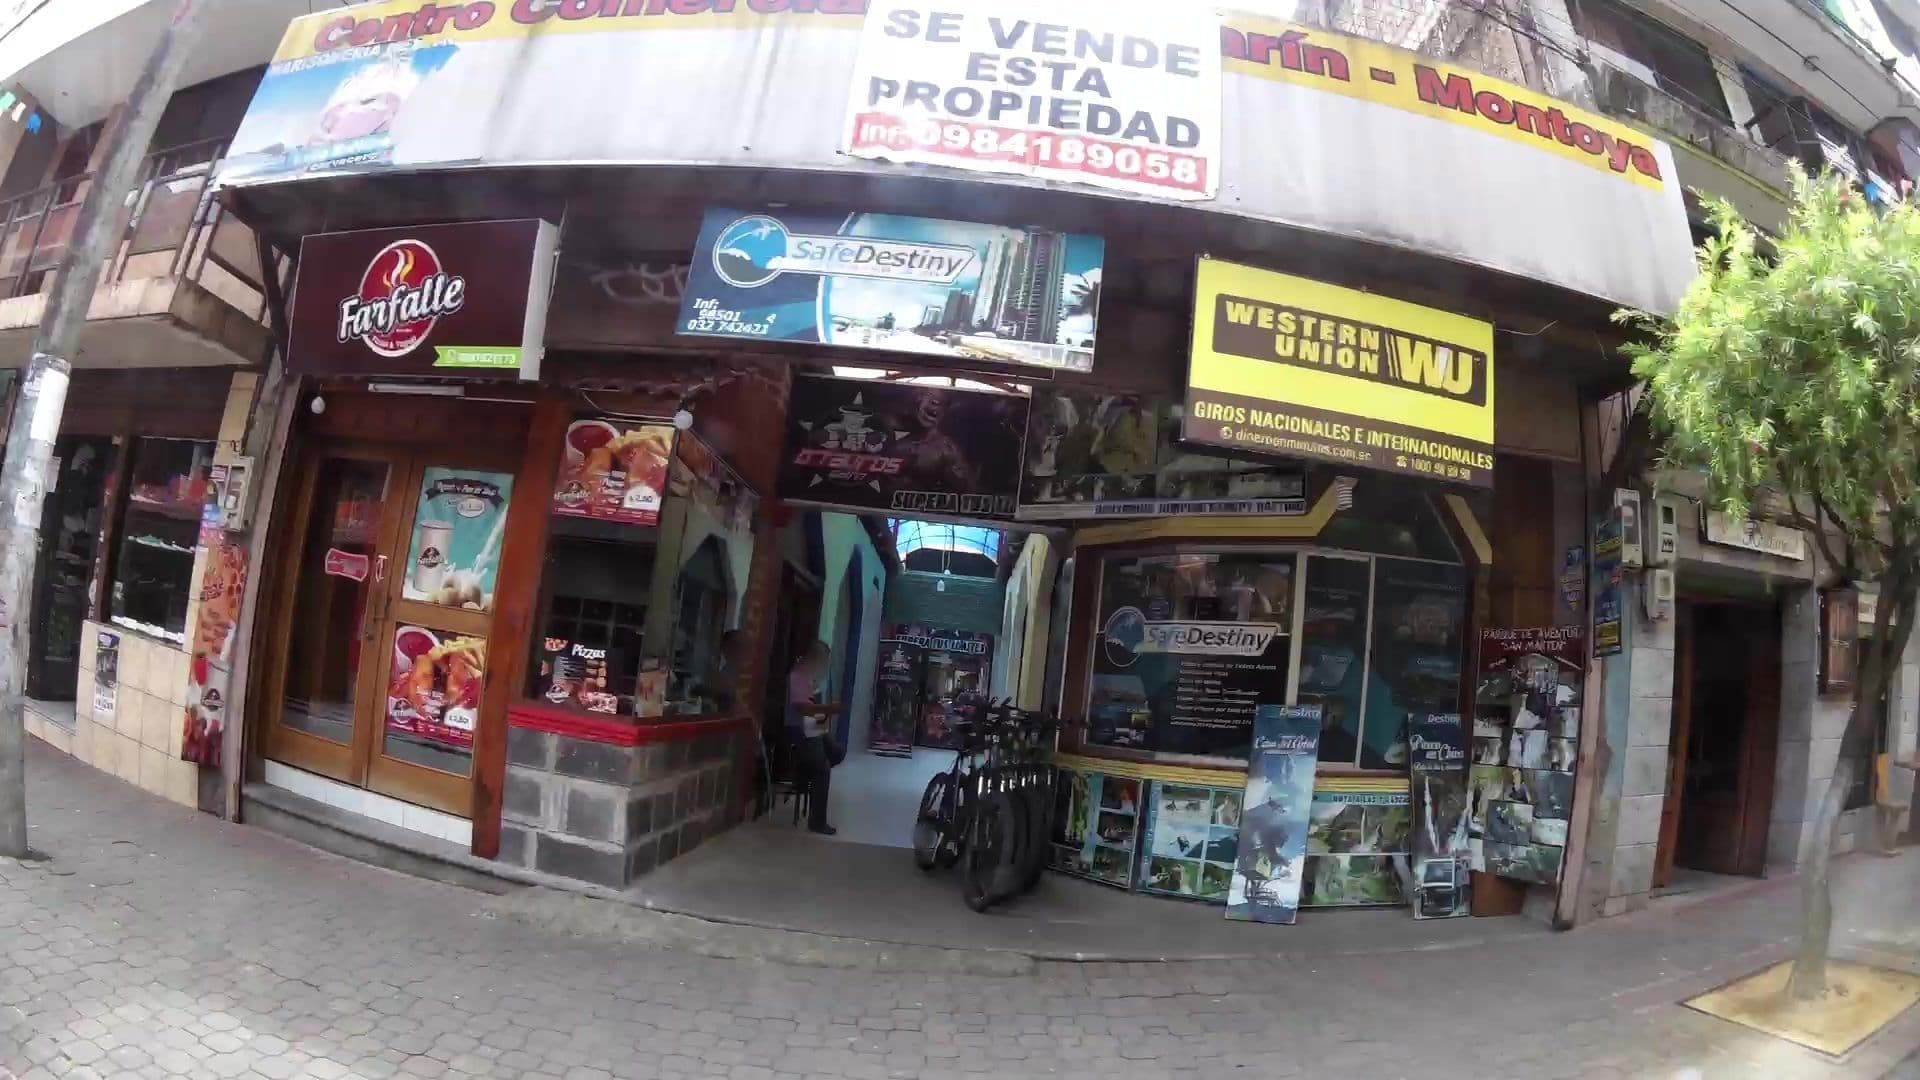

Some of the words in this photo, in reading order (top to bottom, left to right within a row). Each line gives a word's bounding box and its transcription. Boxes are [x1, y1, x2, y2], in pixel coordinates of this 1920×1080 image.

[314, 1, 495, 51] Centro
[883, 9, 964, 42] SE
[987, 17, 1201, 78] VENDE
[965, 52, 1112, 98] ESTA
[867, 76, 1201, 149] PROPIEDAD
[1415, 54, 1661, 182] Montoya
[914, 122, 1198, 185] 0984189058
[791, 241, 964, 276] SafeDestiny
[339, 273, 464, 341] Farfalle
[1226, 301, 1380, 350] WESTERN
[1395, 335, 1474, 396] WU
[1275, 334, 1379, 375] UNION
[1194, 401, 1246, 424] GIROS
[1250, 409, 1351, 443] NACIONALES
[1354, 429, 1363, 444] E
[1366, 431, 1494, 470] INTERNACIONALES
[572, 643, 607, 660] Pizzas
[1148, 627, 1269, 650] SafeDestiny
